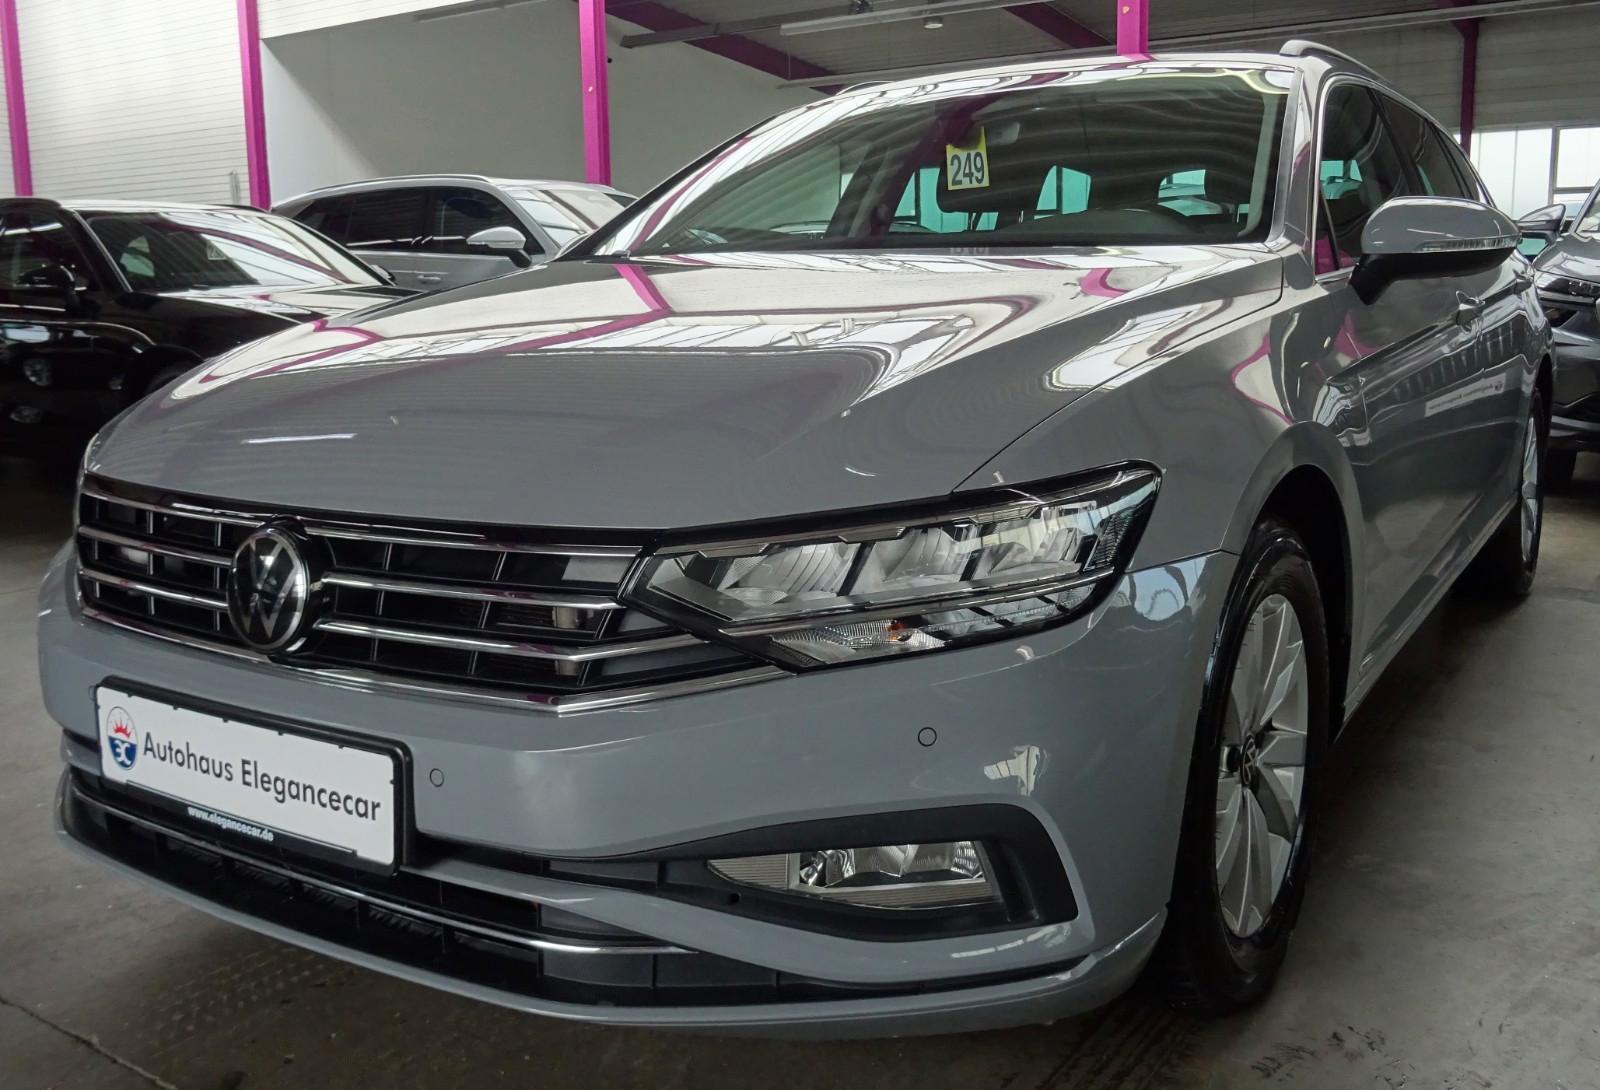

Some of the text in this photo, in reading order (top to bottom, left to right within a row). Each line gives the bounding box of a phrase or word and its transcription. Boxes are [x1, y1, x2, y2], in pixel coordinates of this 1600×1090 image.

[950, 151, 985, 187] 249
[143, 731, 381, 821] Autohaus Elegancecar
[187, 806, 274, 842] www.elegancecar.de
